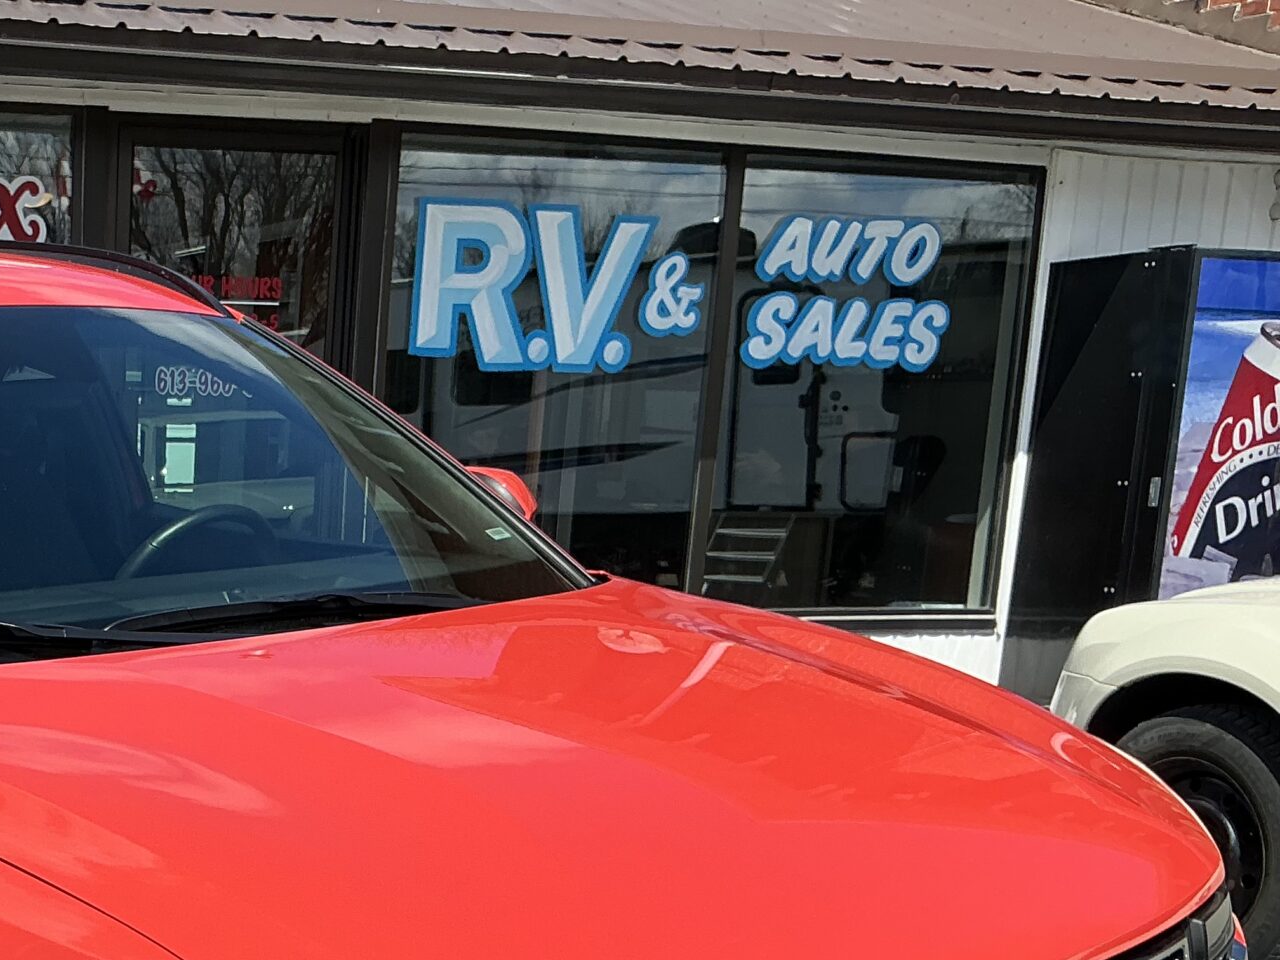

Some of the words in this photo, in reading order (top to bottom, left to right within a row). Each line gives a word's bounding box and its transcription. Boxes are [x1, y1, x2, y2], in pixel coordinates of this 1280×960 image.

[221, 274, 283, 299] HOURS
[754, 216, 942, 286] AUTO
[639, 252, 705, 337] &
[740, 291, 950, 372] SALES
[1210, 383, 1280, 463] Cold
[1193, 457, 1238, 529] REFRESHING
